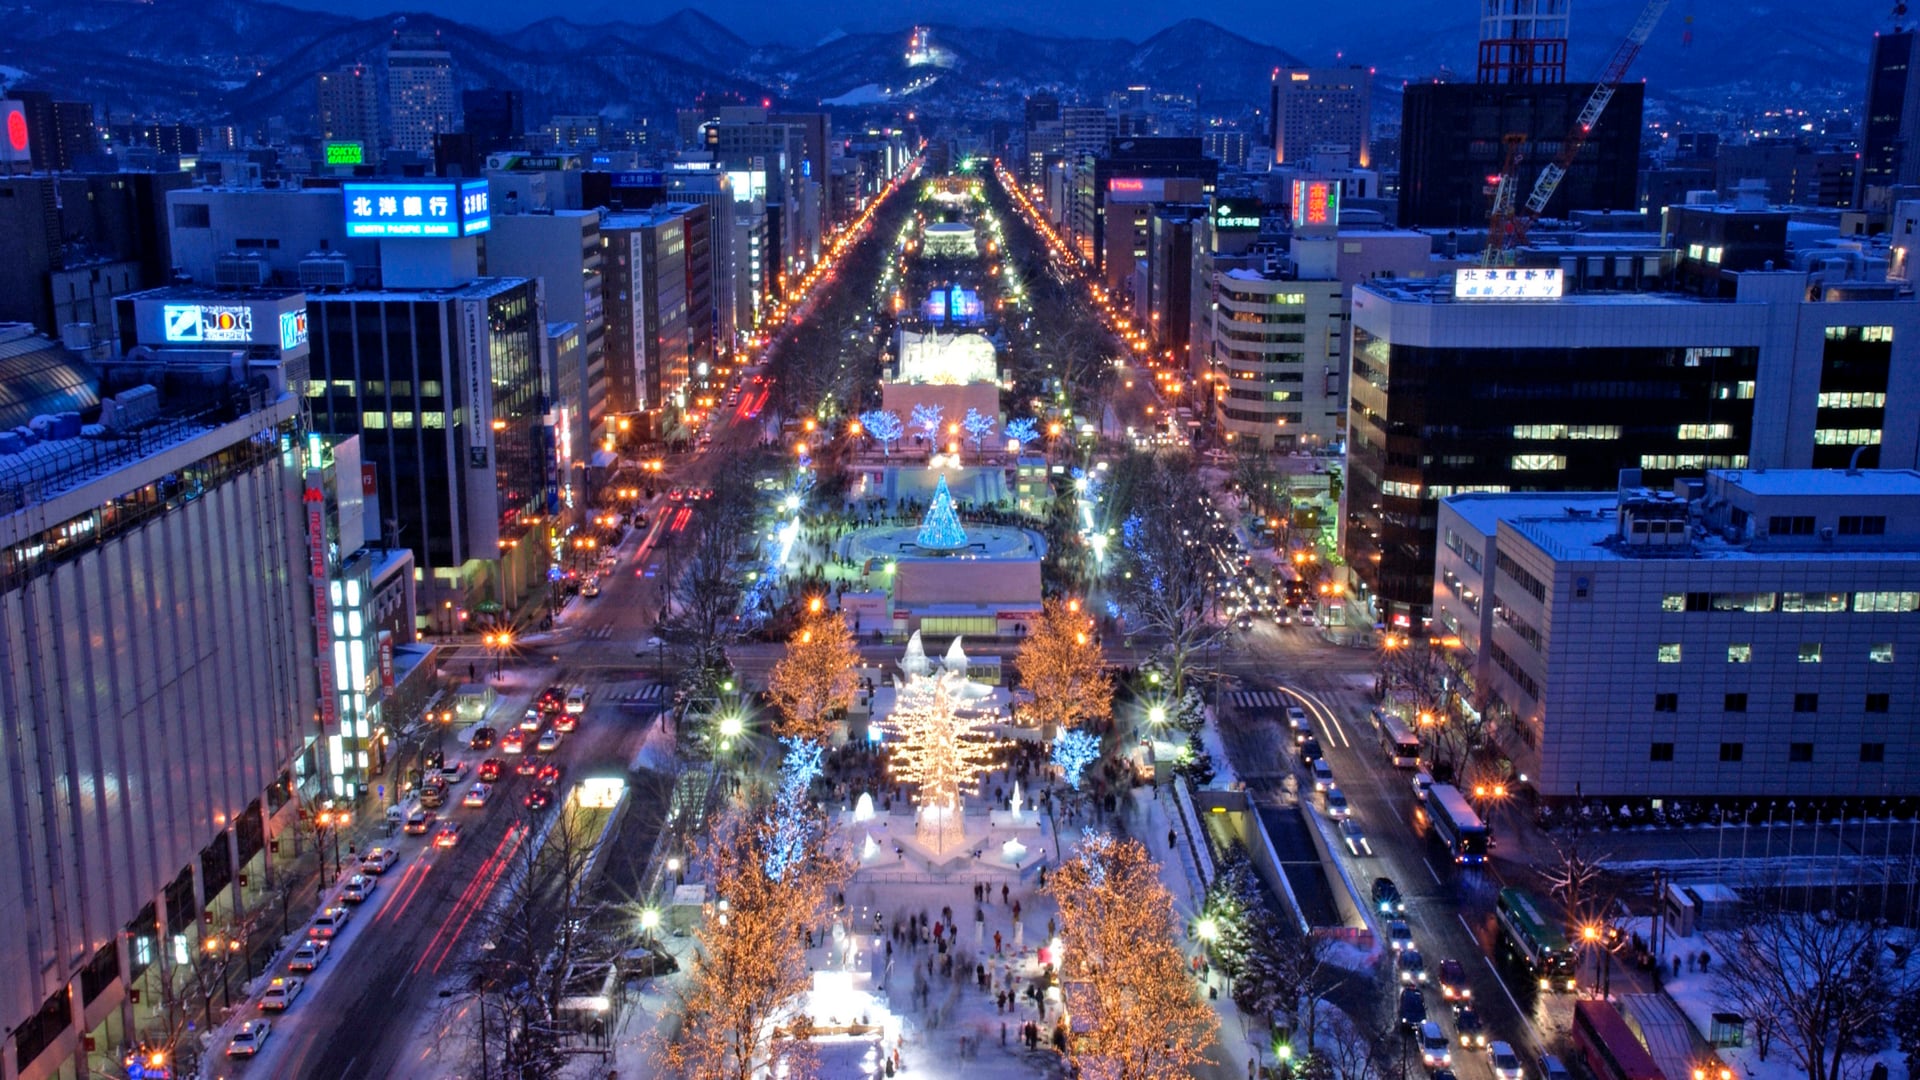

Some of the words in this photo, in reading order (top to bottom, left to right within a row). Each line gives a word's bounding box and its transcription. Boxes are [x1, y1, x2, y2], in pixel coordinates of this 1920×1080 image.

[328, 147, 361, 156] TOKYU
[353, 196, 448, 216] 北洋銀行
[1218, 217, 1260, 227] 住友不動産
[1465, 270, 1556, 281] 北海道新聞
